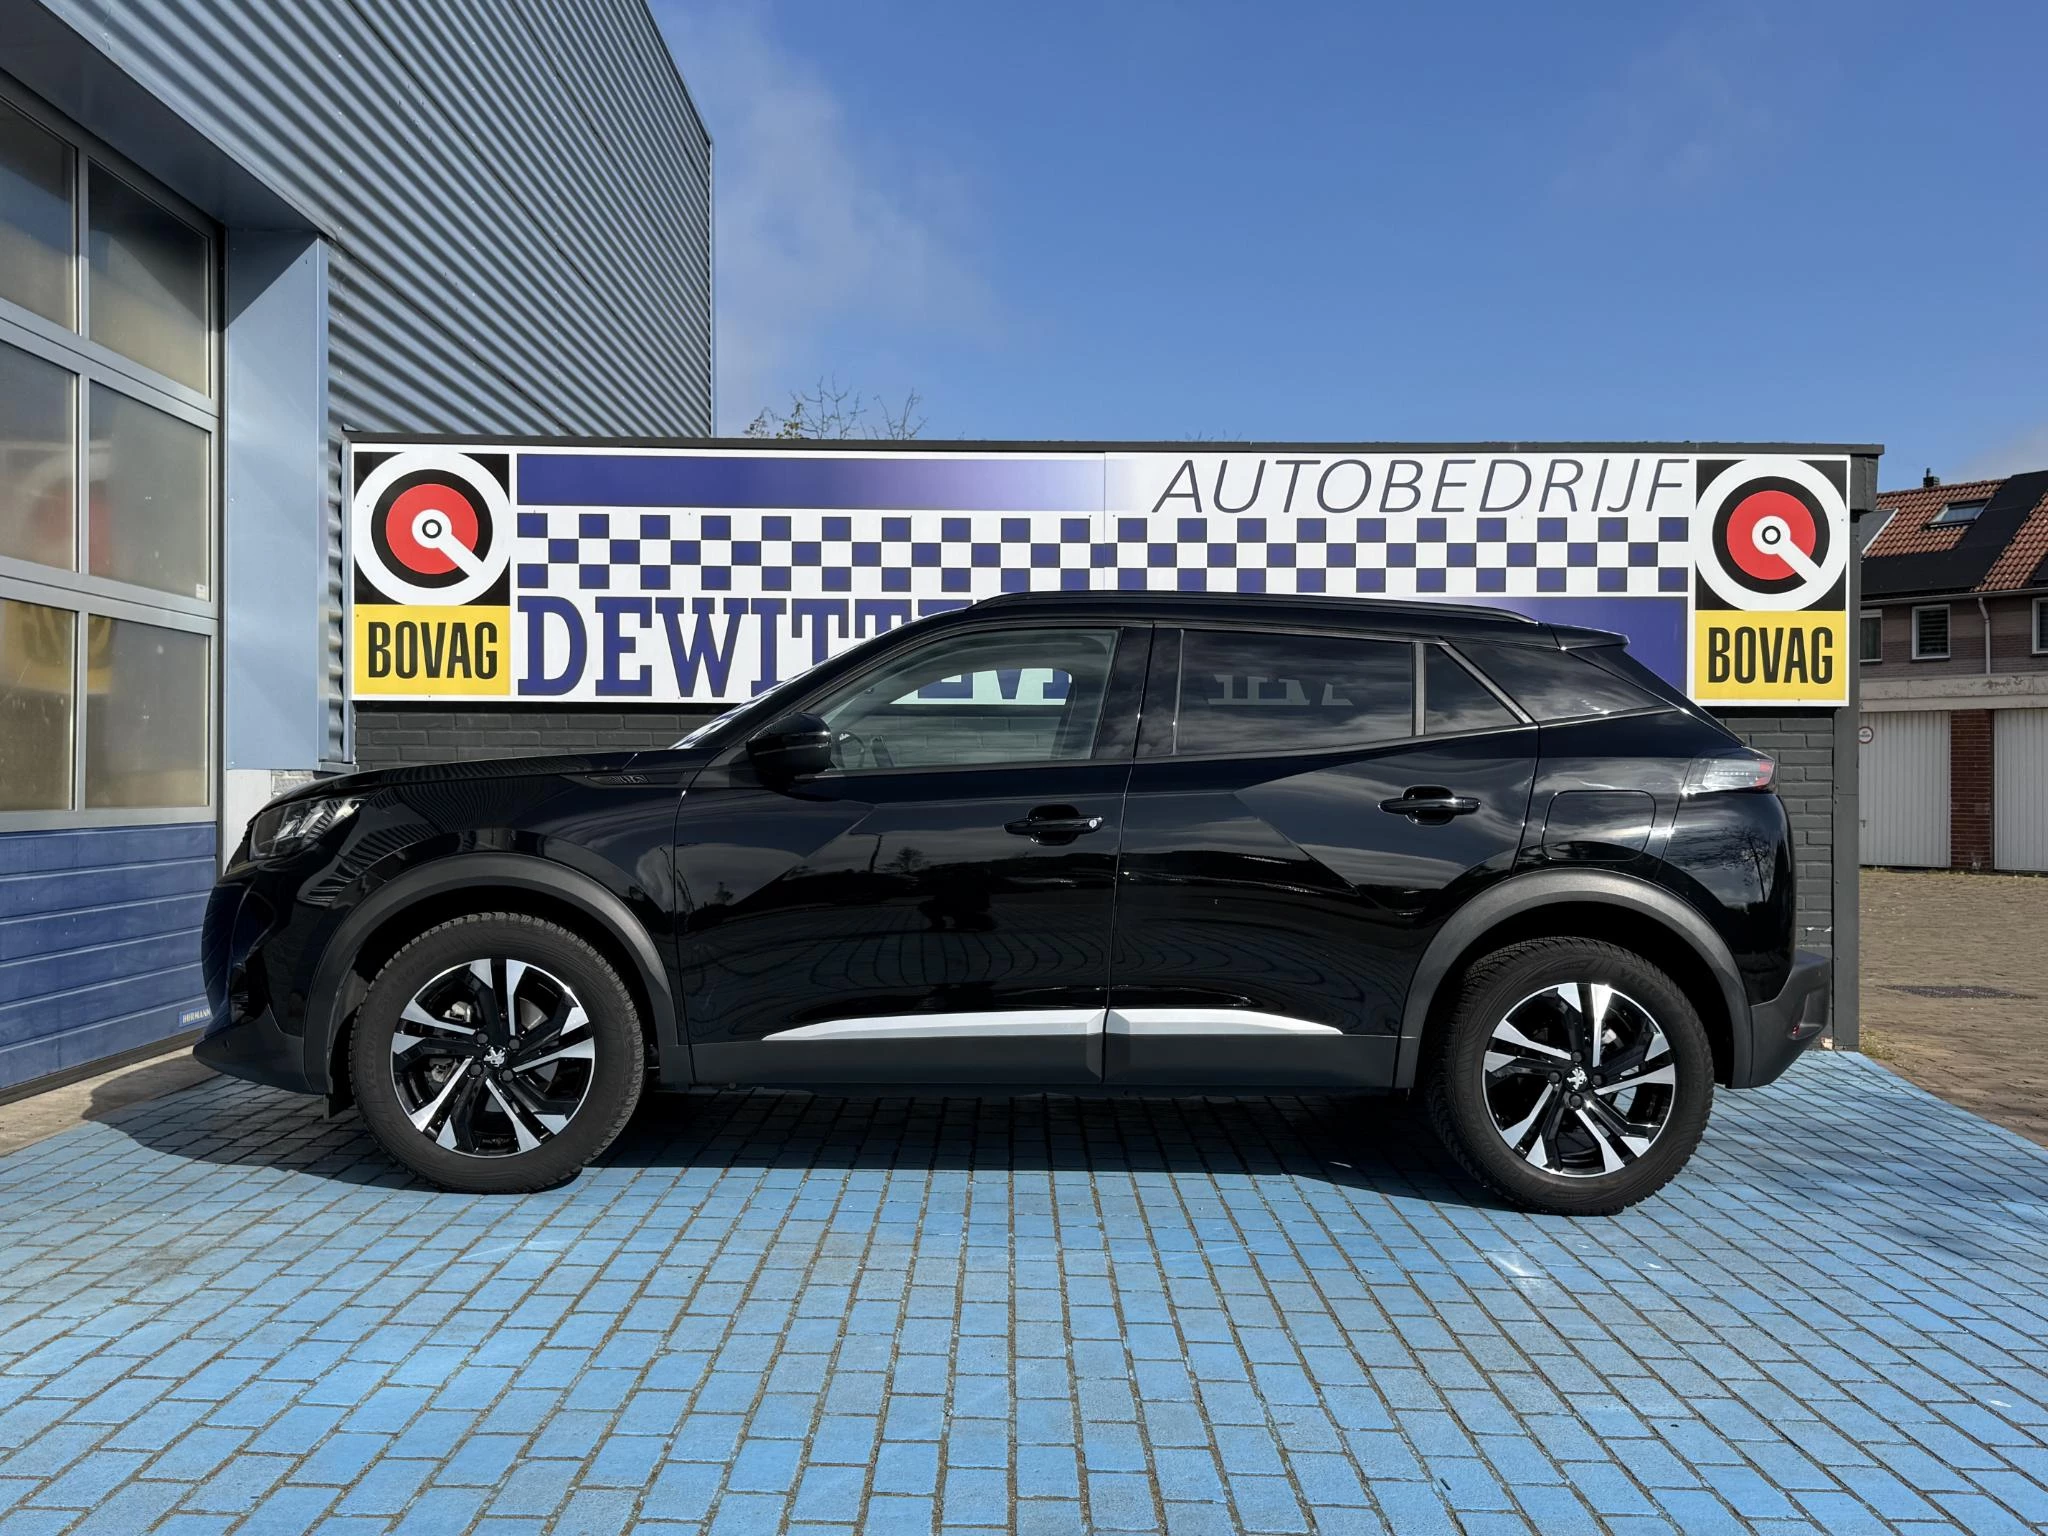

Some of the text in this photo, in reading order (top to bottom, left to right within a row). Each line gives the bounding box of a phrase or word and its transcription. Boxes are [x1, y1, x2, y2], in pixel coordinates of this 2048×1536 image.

[1152, 459, 1690, 513] AUTOBEDRIJF
[368, 621, 498, 679] BOVAG
[1708, 627, 1833, 685] BOVAG
